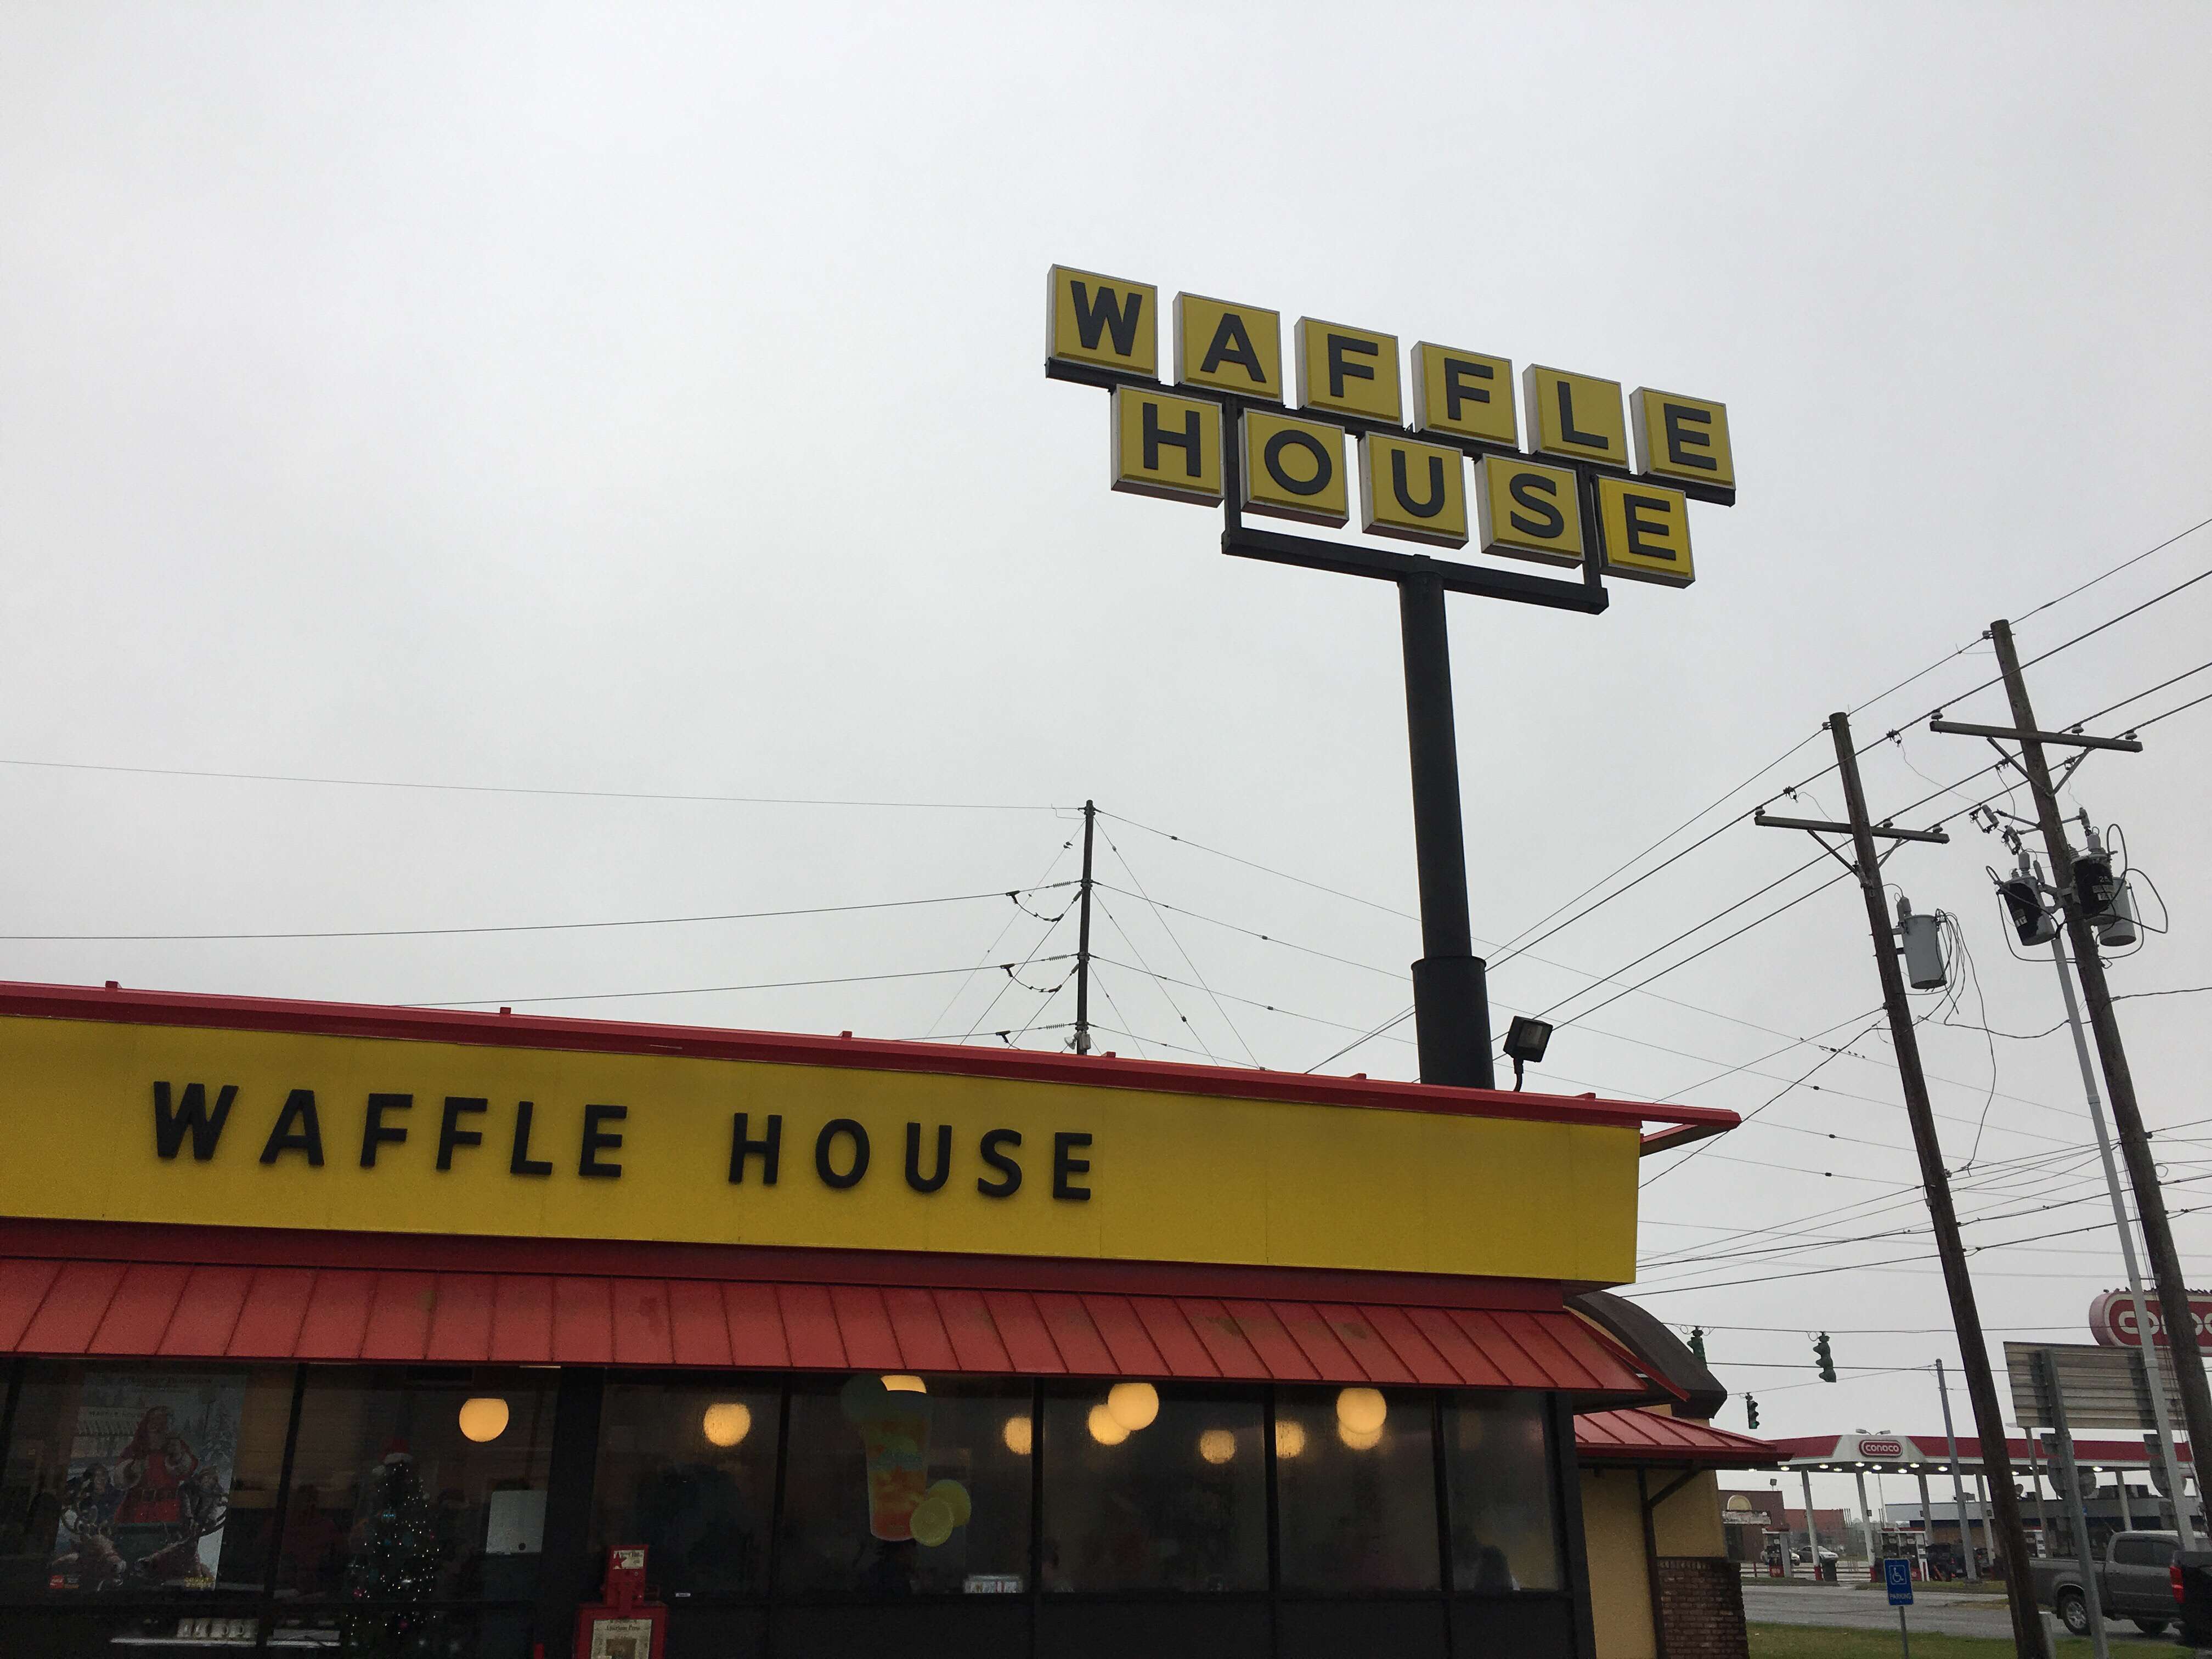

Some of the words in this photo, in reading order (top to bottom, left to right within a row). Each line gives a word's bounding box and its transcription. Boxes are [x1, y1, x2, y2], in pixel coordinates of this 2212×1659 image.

[1070, 280, 1718, 471] WAFFLE
[1142, 402, 1677, 561] HOUSE
[153, 1080, 628, 1178] WAFFLE
[727, 1111, 1093, 1201] HOUSE
